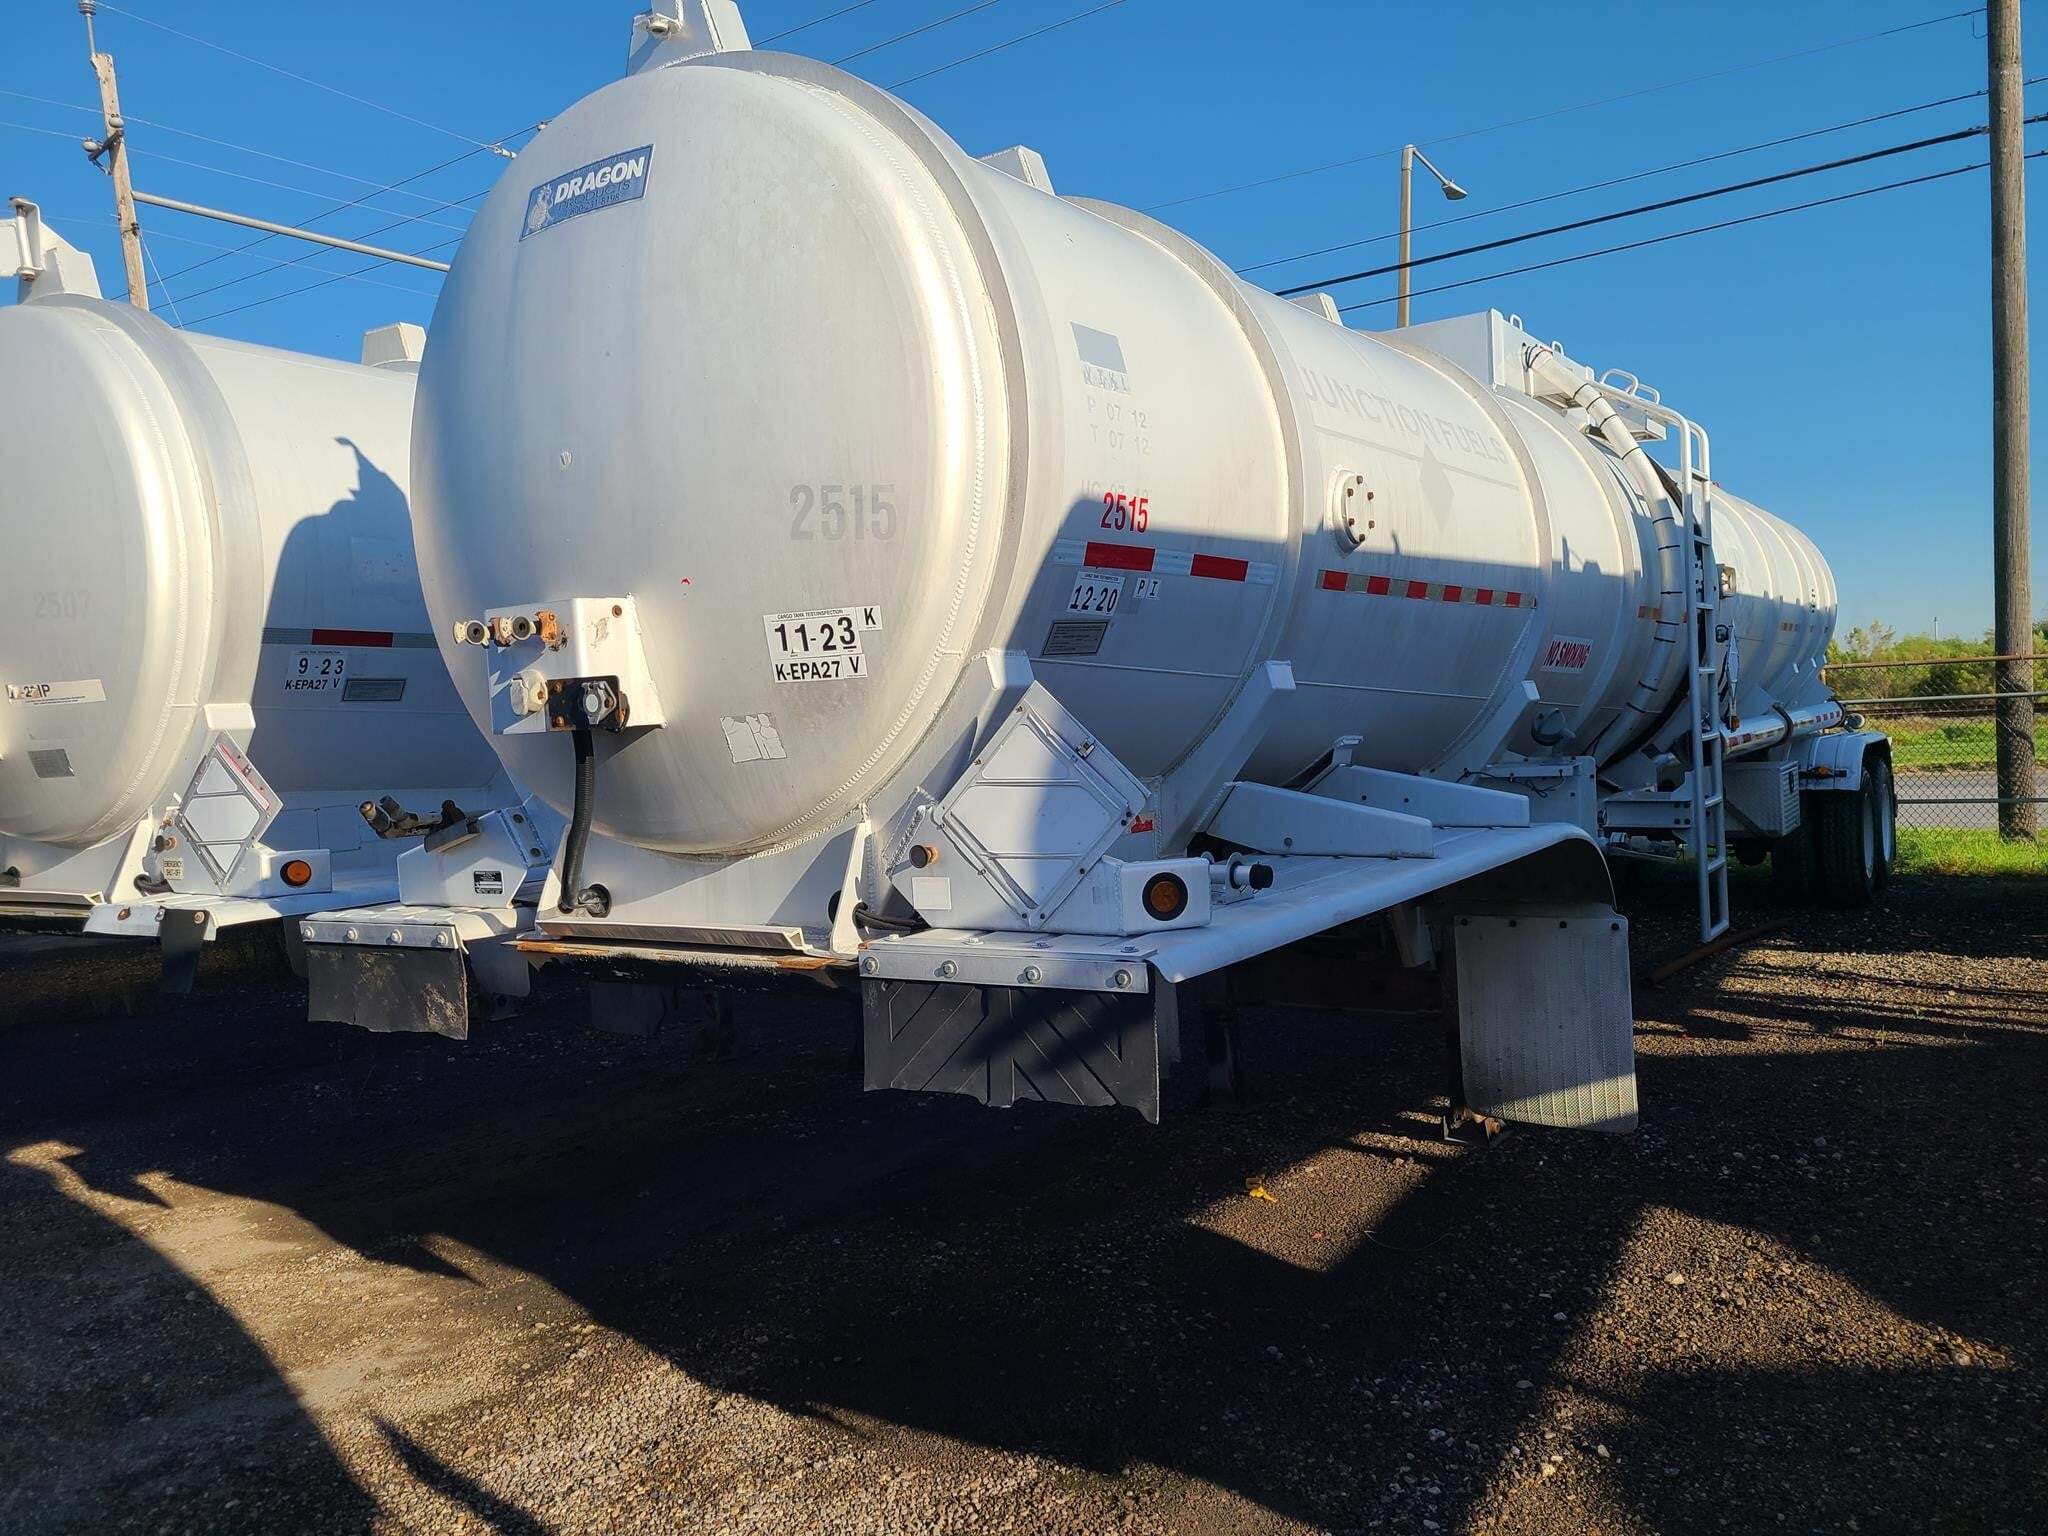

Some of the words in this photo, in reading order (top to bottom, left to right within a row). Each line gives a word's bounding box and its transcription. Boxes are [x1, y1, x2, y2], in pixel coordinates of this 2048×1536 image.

[554, 157, 645, 206] DRAGON
[1106, 403, 1121, 422] 07
[1131, 410, 1147, 428] 12
[1302, 366, 1440, 445] JUNCTION
[1438, 418, 1509, 464] FUELS
[790, 485, 896, 540] 2515
[1101, 492, 1148, 533] 2515
[1070, 585, 1118, 612] 12-20
[1137, 580, 1145, 595] P
[1149, 581, 1158, 597] I
[775, 617, 855, 651] 11-23
[864, 608, 876, 625] K
[775, 660, 840, 681] K-EPA27
[849, 656, 859, 674] V
[1543, 640, 1561, 666] NO
[1555, 641, 1590, 669] SMOKING
[285, 679, 328, 690] K-EPA27
